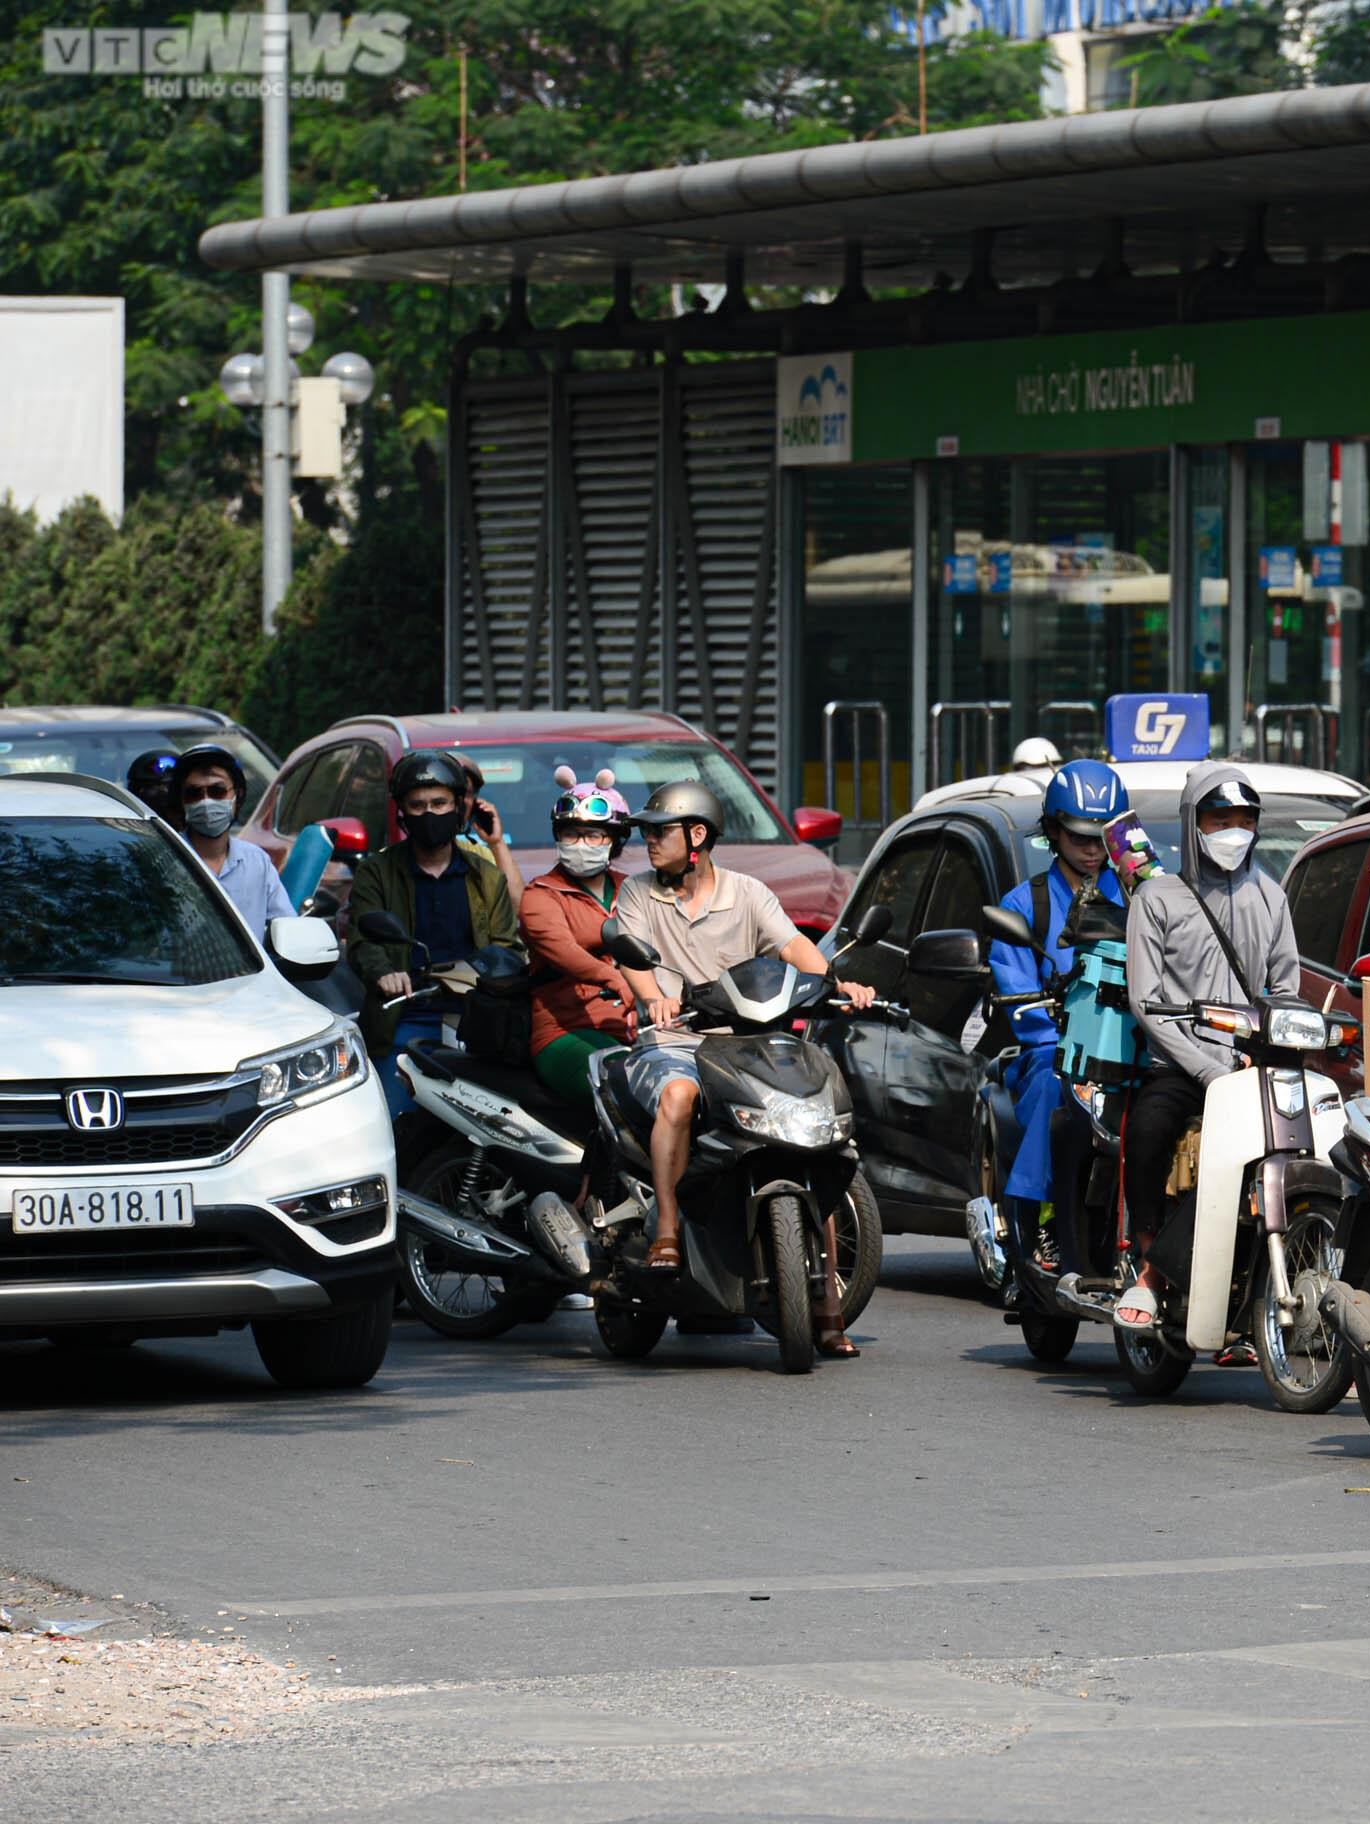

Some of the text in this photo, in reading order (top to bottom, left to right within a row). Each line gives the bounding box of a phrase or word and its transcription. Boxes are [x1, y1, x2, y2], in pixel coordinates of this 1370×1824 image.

[781, 413, 847, 447] HANOI BRT
[1134, 702, 1187, 755] G7
[1131, 743, 1159, 755] TAXI
[19, 1188, 184, 1226] 30A-818.11
